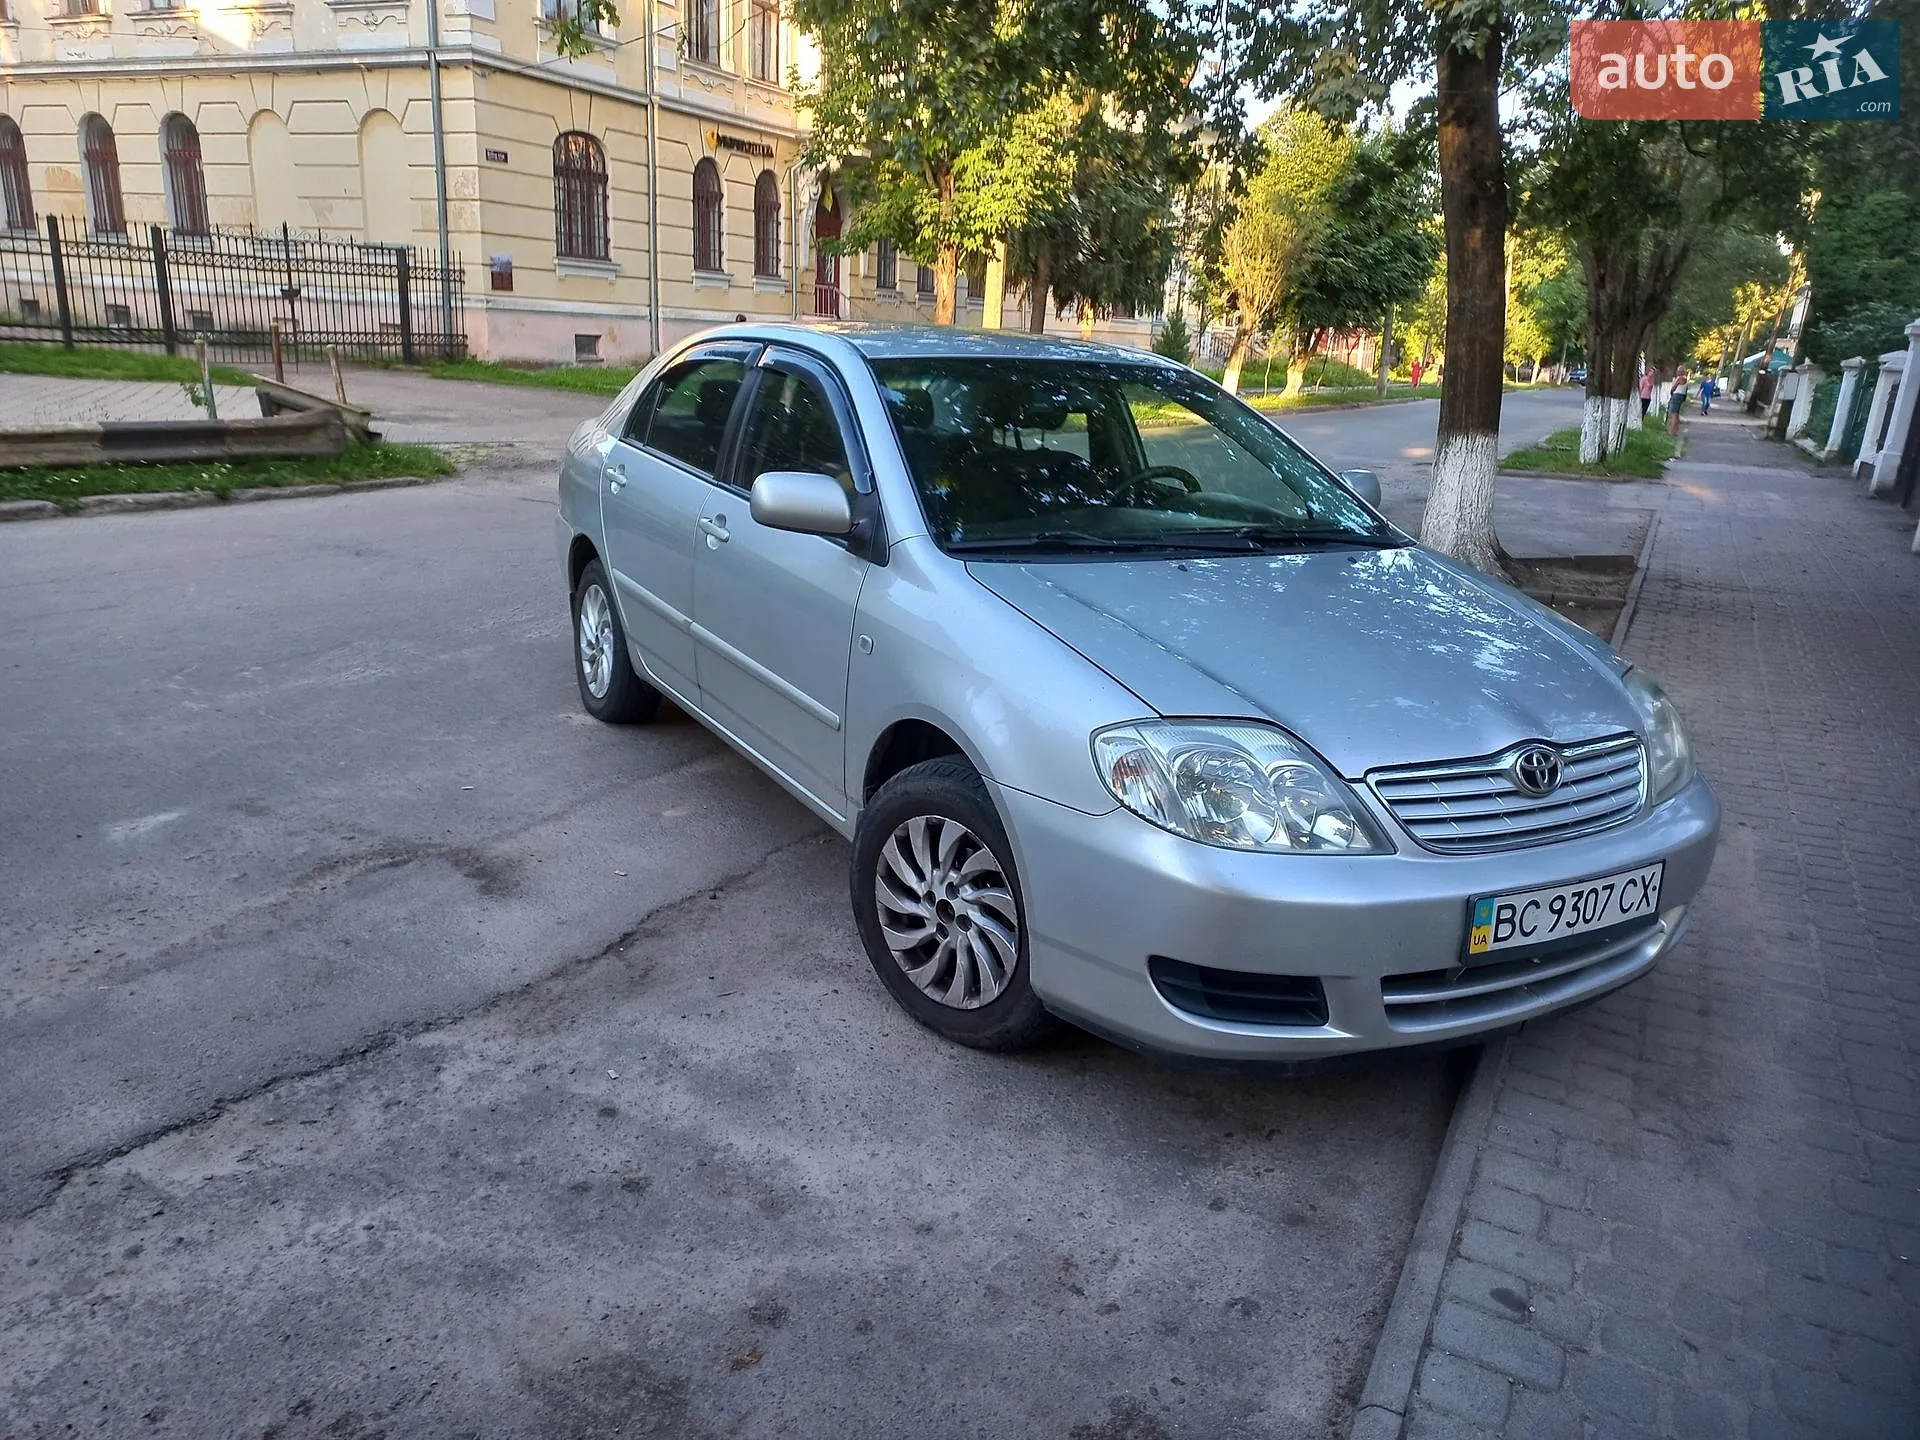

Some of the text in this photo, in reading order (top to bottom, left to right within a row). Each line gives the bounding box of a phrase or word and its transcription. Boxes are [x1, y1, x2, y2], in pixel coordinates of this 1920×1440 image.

[1492, 871, 1656, 943] BC 9307 CX
[1473, 935, 1488, 946] UA
